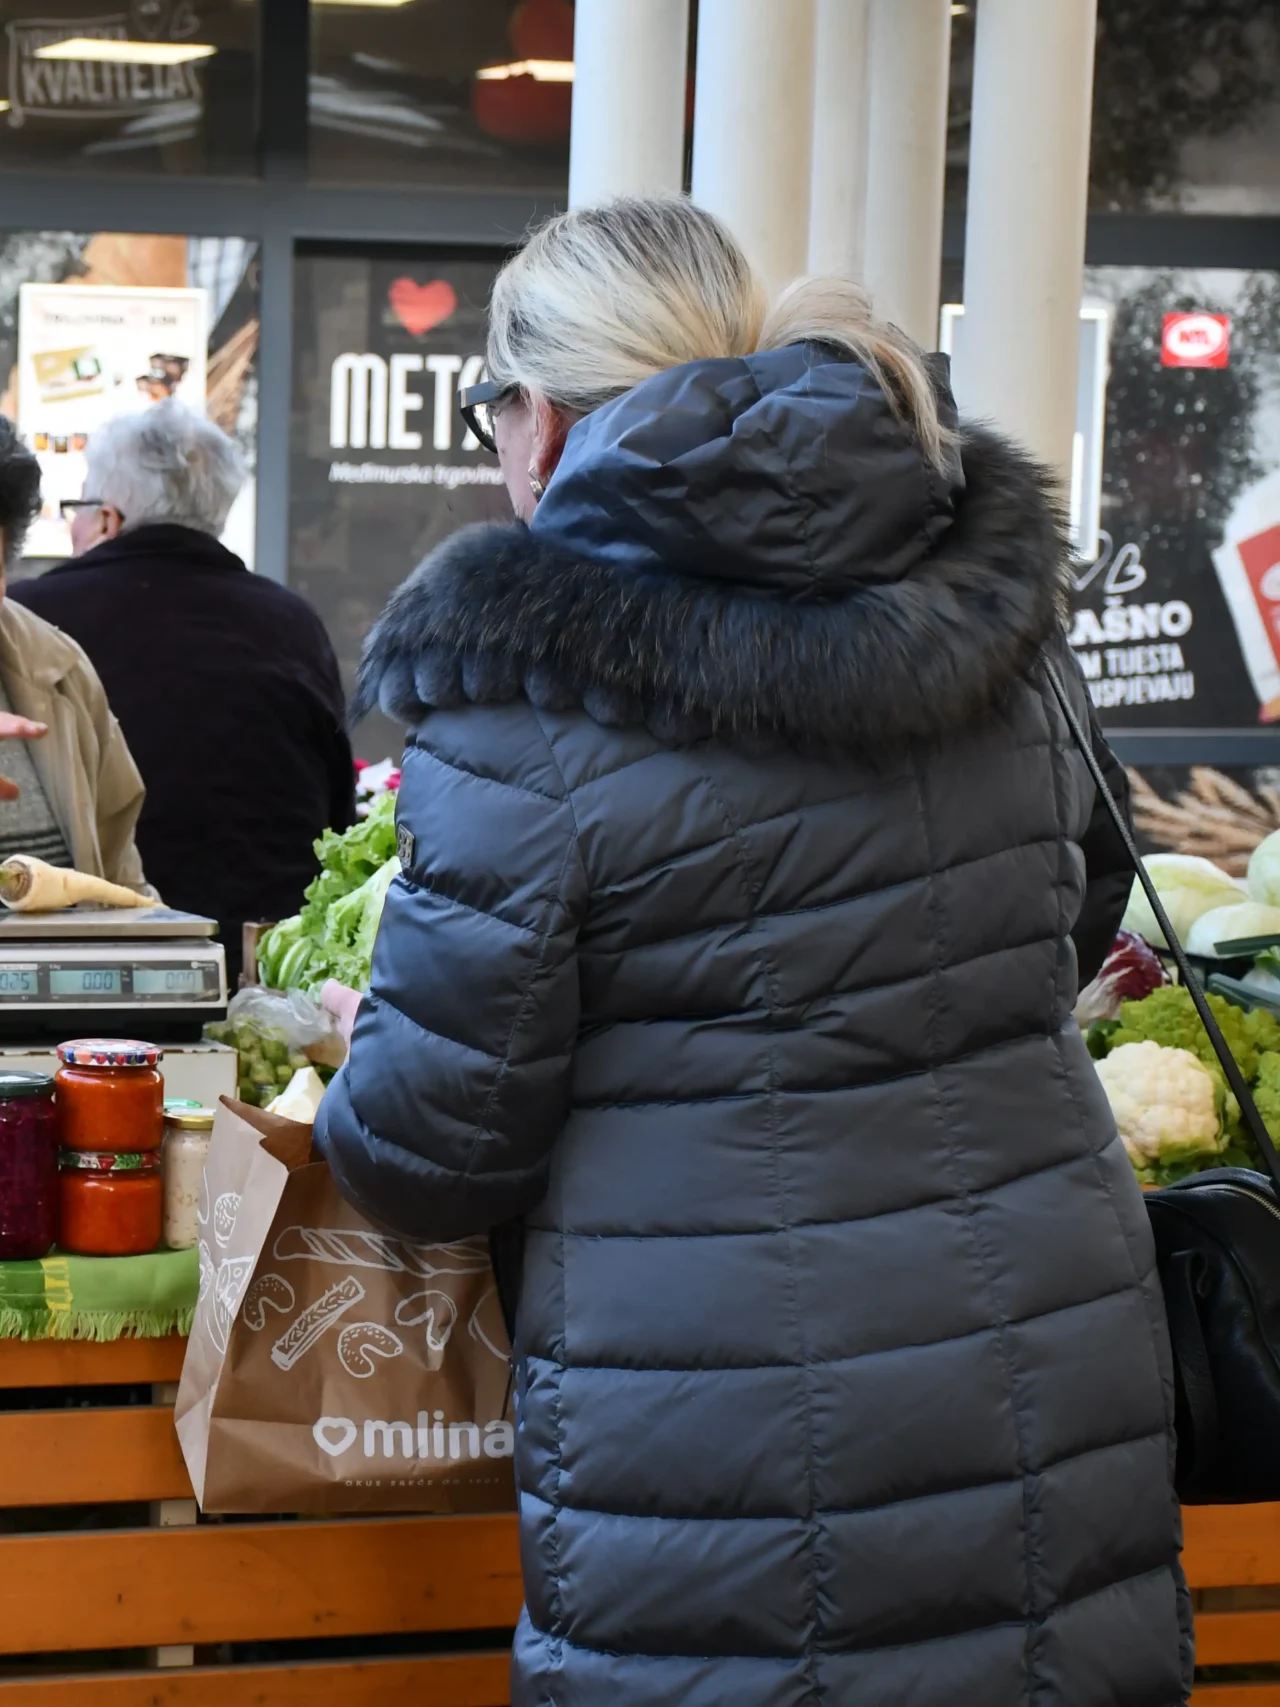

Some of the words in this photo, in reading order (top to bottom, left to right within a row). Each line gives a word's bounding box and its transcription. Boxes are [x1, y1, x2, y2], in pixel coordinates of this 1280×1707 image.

[1067, 595, 1192, 646] AŠNO
[363, 1409, 515, 1460] mlina
[344, 1479, 382, 1487] OKUS
